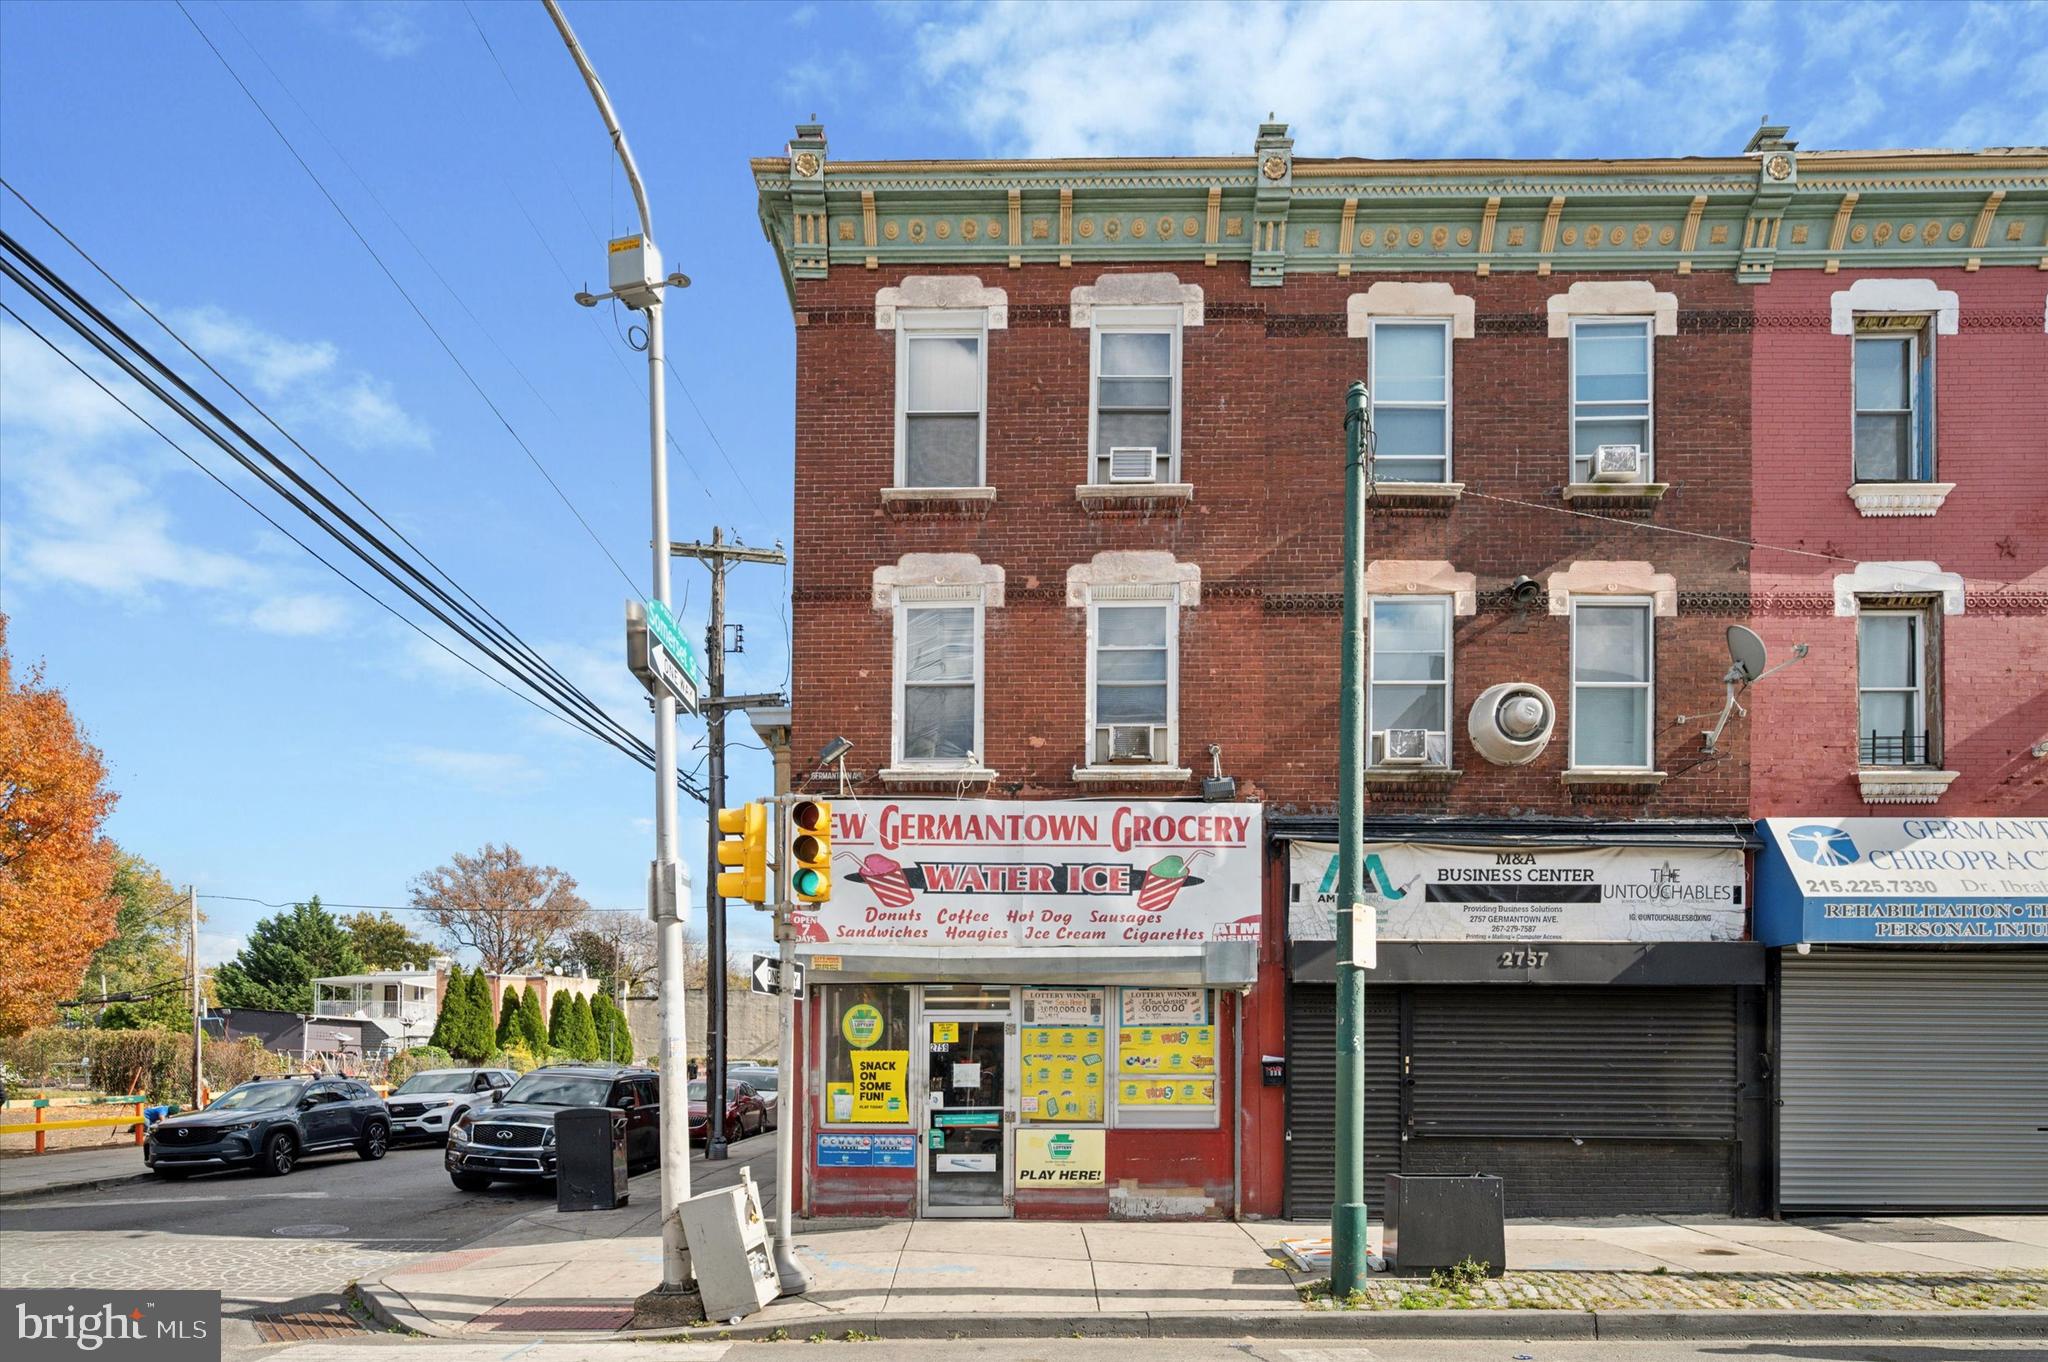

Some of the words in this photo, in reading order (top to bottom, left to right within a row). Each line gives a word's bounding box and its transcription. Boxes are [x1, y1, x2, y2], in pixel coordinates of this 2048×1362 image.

[831, 814, 867, 839] EW
[879, 804, 1098, 851] GERMANTOWN
[1112, 806, 1251, 852] GROCERY
[1496, 853, 1537, 865] M&A
[1868, 849, 2048, 871] CHIROPRAC
[923, 864, 1057, 893] WATER
[1067, 865, 1129, 893] ICE
[1437, 868, 1522, 882] BUSINESS
[1527, 868, 1594, 882] CENTER
[1650, 868, 1681, 883] THE
[1603, 884, 1731, 900] UNTOUCHABLES
[1805, 879, 1938, 894] 215.225.7330
[1960, 879, 1996, 893] Dr.
[1463, 905, 1497, 913] Providing
[1498, 905, 1529, 913] Business
[1530, 905, 1563, 913] Solutions
[793, 915, 817, 924] OPEN
[865, 906, 922, 923] Donuts
[936, 907, 989, 925] Coffee
[1006, 908, 1034, 924] Hot
[1041, 909, 1073, 926] Dog
[1089, 910, 1162, 926] Sausages
[1469, 915, 1486, 923] 2757
[1487, 915, 1541, 923] GERMANTOWN
[1542, 915, 1559, 923] AVE.
[1637, 913, 1712, 922] @UNTOUCHABLESBOXING
[801, 924, 811, 936] 7
[836, 925, 929, 938] Sandwiches
[945, 926, 1009, 942] Hoagies
[1024, 926, 1050, 940] Ice
[1056, 926, 1106, 940] Cream
[1123, 926, 1205, 943] Cigarettes
[1213, 923, 1260, 934] ATM
[1491, 925, 1537, 933] 267-279-7587
[1875, 922, 1992, 938] PERSONAL
[1993, 922, 2048, 938] INJU
[795, 935, 817, 944] DAYS
[1501, 952, 1549, 967] 2757
[859, 1061, 896, 1071] SNACK
[859, 1072, 877, 1081] ON
[859, 1082, 892, 1091] SOME
[859, 1092, 885, 1101] FUN!
[1020, 1170, 1056, 1180] PLAY
[1059, 1170, 1102, 1180] HERE!
